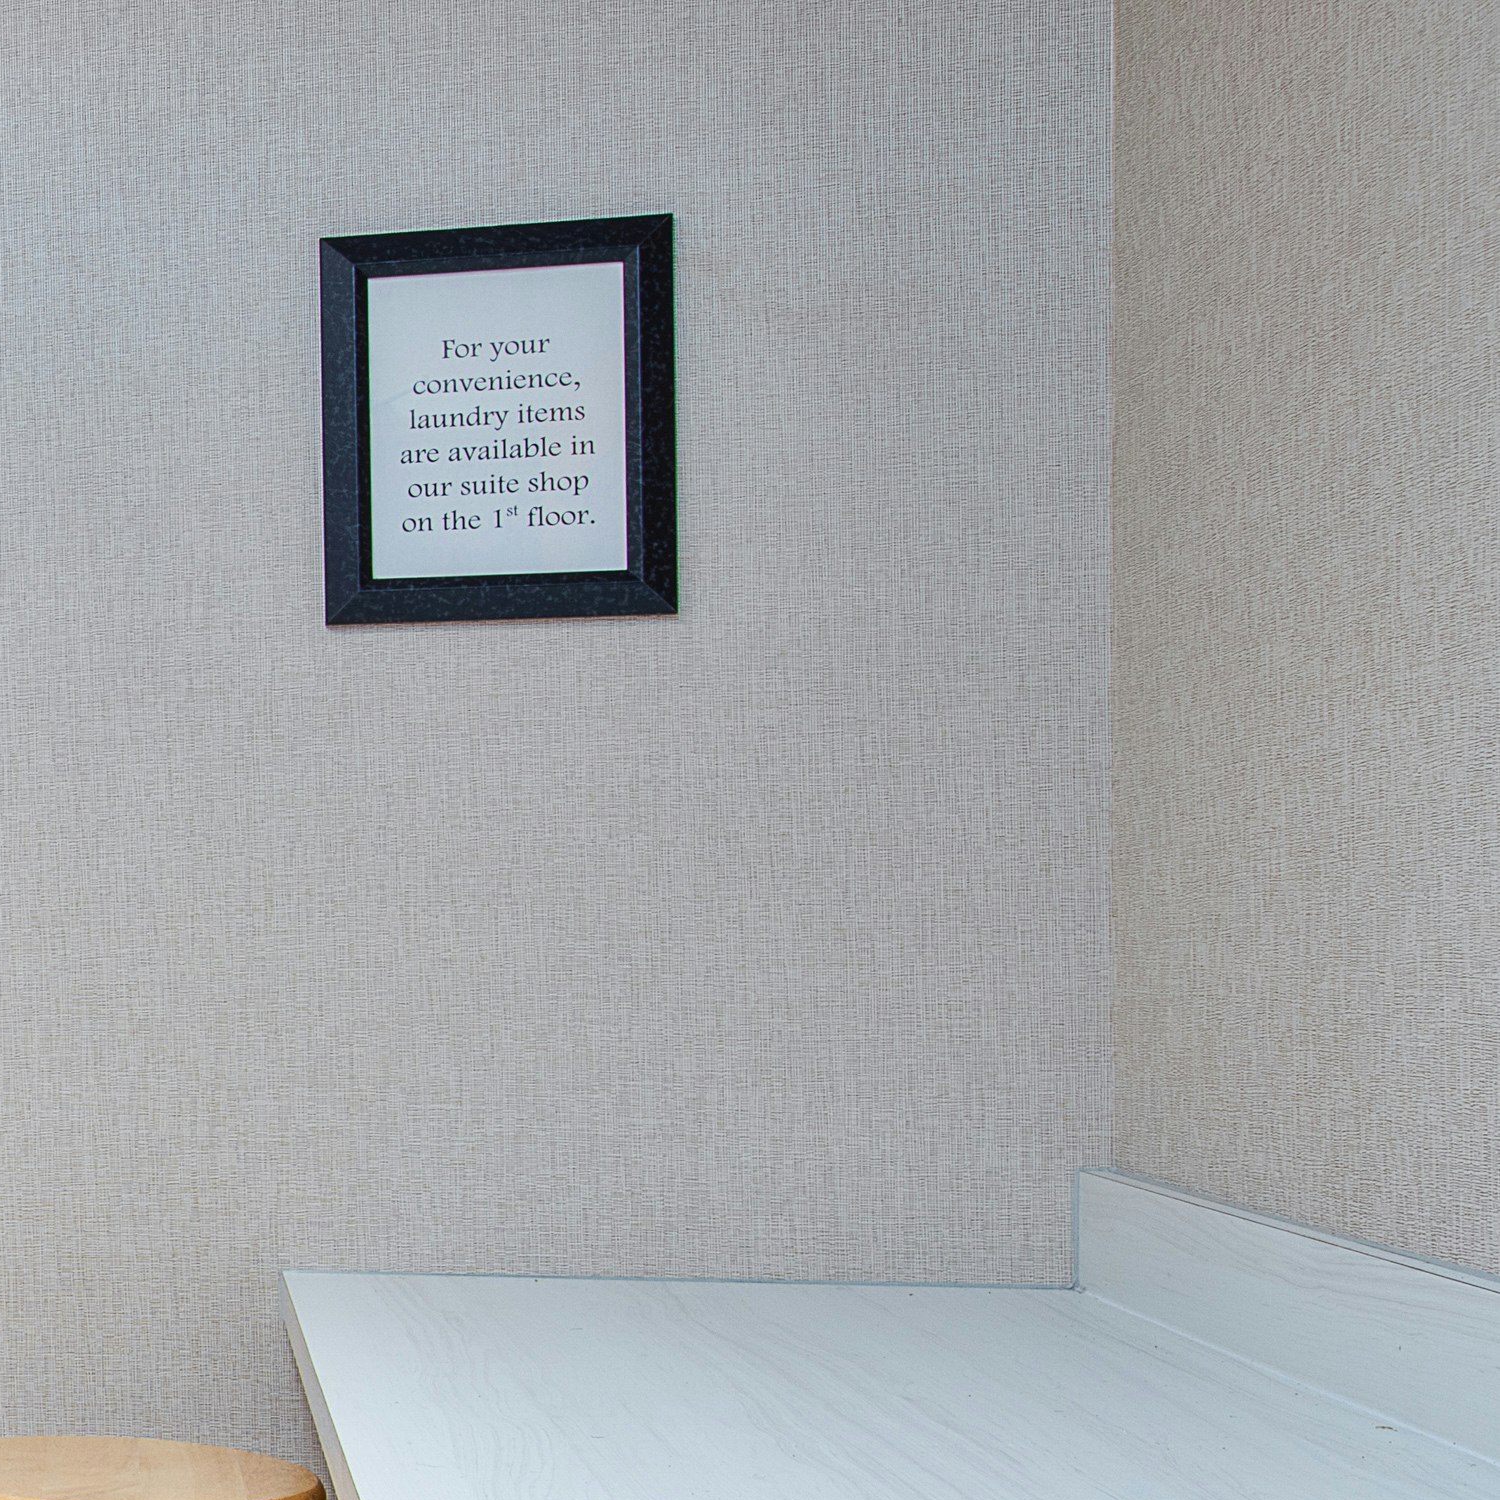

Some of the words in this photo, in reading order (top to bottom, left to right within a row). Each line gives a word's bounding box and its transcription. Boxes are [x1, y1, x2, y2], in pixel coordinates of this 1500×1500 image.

[443, 340, 482, 358] For
[490, 338, 550, 362] your
[413, 370, 580, 394] convenience,
[411, 406, 509, 431] laundry
[519, 404, 585, 423] items
[400, 447, 440, 464] are
[449, 437, 561, 461] available
[572, 436, 595, 455] in
[408, 482, 452, 497] our
[461, 475, 519, 495] suite
[529, 472, 588, 495] shop
[402, 516, 433, 532] on
[443, 510, 480, 530] the
[495, 505, 519, 528] 1st
[529, 506, 595, 526] floor.
